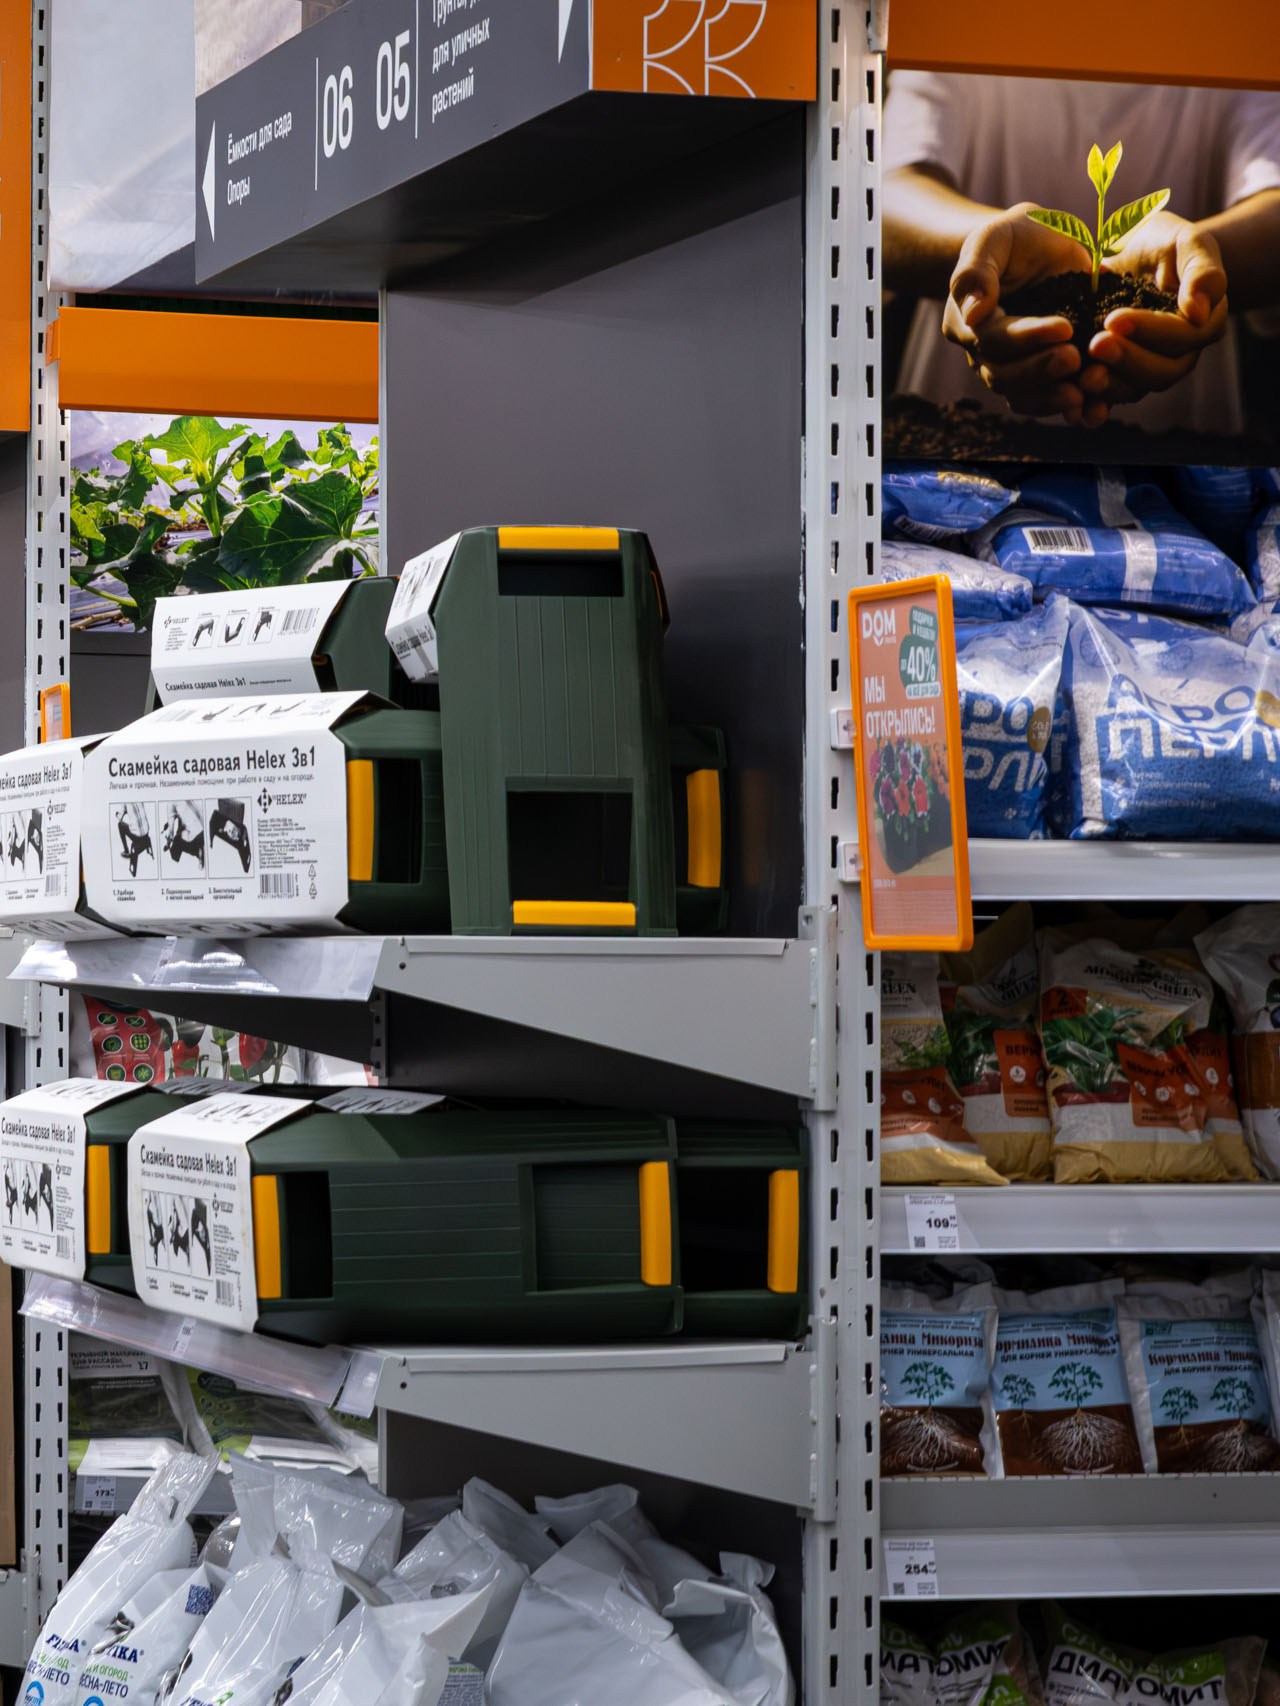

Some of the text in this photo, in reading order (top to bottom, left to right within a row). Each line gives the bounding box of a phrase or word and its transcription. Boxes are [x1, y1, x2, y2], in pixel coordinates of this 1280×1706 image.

[432, 17, 490, 74] для уличных
[376, 29, 410, 130] 05
[432, 66, 474, 124] растений
[323, 65, 353, 158] 06
[227, 111, 292, 165] Ёмкости для сада
[227, 176, 250, 206] Опоры
[907, 645, 936, 682] 40%
[165, 681, 194, 692] Скамейка
[194, 681, 217, 690] садовая
[218, 679, 234, 688] Helex
[864, 675, 886, 705] МЫ
[865, 705, 937, 739] ОТКРЫЛИСЬ!
[108, 745, 316, 777] Скамейка садовая Helex 3в1
[17, 770, 42, 790] садовая
[43, 764, 60, 785] Helex
[237, 776, 257, 784] работе
[1, 1116, 28, 1138] Скамейка
[29, 1123, 50, 1140] садовая
[51, 1122, 66, 1142] Helex
[140, 1144, 175, 1168] Скамейка
[176, 1153, 204, 1172] садовая
[205, 1151, 225, 1174] Helex
[926, 1218, 950, 1229] 109
[922, 1330, 983, 1351] Микориза
[996, 1334, 1062, 1352] ормилица
[1019, 1350, 1052, 1361] КОРНЕЙ
[99, 1667, 128, 1682] ОГОРОД
